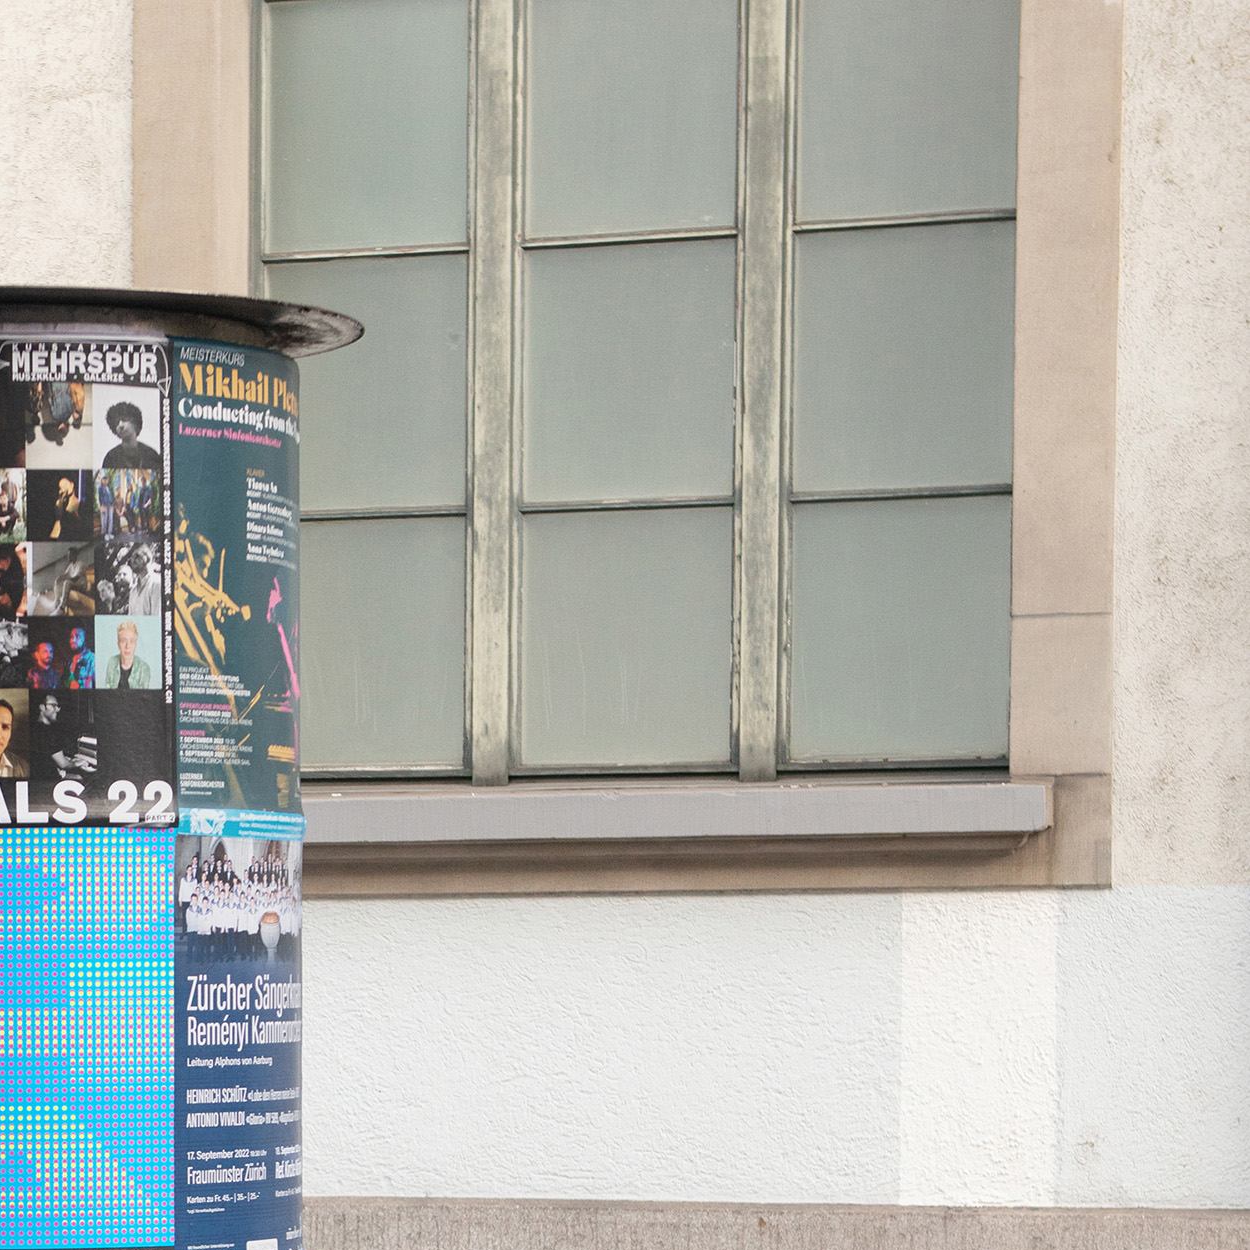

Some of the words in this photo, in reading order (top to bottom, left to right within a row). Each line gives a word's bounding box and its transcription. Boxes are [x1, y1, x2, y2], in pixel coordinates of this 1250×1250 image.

[12, 343, 158, 352] KUNSTAPPARAT
[180, 347, 245, 367] MEISTERKURS
[12, 350, 158, 376] MEHRSPUR
[140, 374, 157, 383] BAR
[179, 363, 269, 405] Mikhail
[178, 397, 263, 432] Conducting
[179, 423, 222, 439] Luzerner
[107, 780, 174, 823] 22
[145, 813, 167, 823] PART
[170, 813, 175, 822] 2
[187, 974, 253, 1011] Zürcher
[187, 1014, 249, 1052] Reményi
[187, 1057, 214, 1069] Leitung
[215, 1057, 241, 1067] Alphons
[242, 1058, 252, 1066] von
[186, 1088, 222, 1104] HEINRICH
[222, 1085, 248, 1103] SCHÜTZ
[186, 1112, 219, 1128] ANTONIO
[220, 1111, 246, 1127] VIVALDI
[196, 1149, 234, 1161] September
[235, 1149, 250, 1158] 2022
[187, 1165, 245, 1185] Fraumünster
[245, 1162, 267, 1182] Zürich
